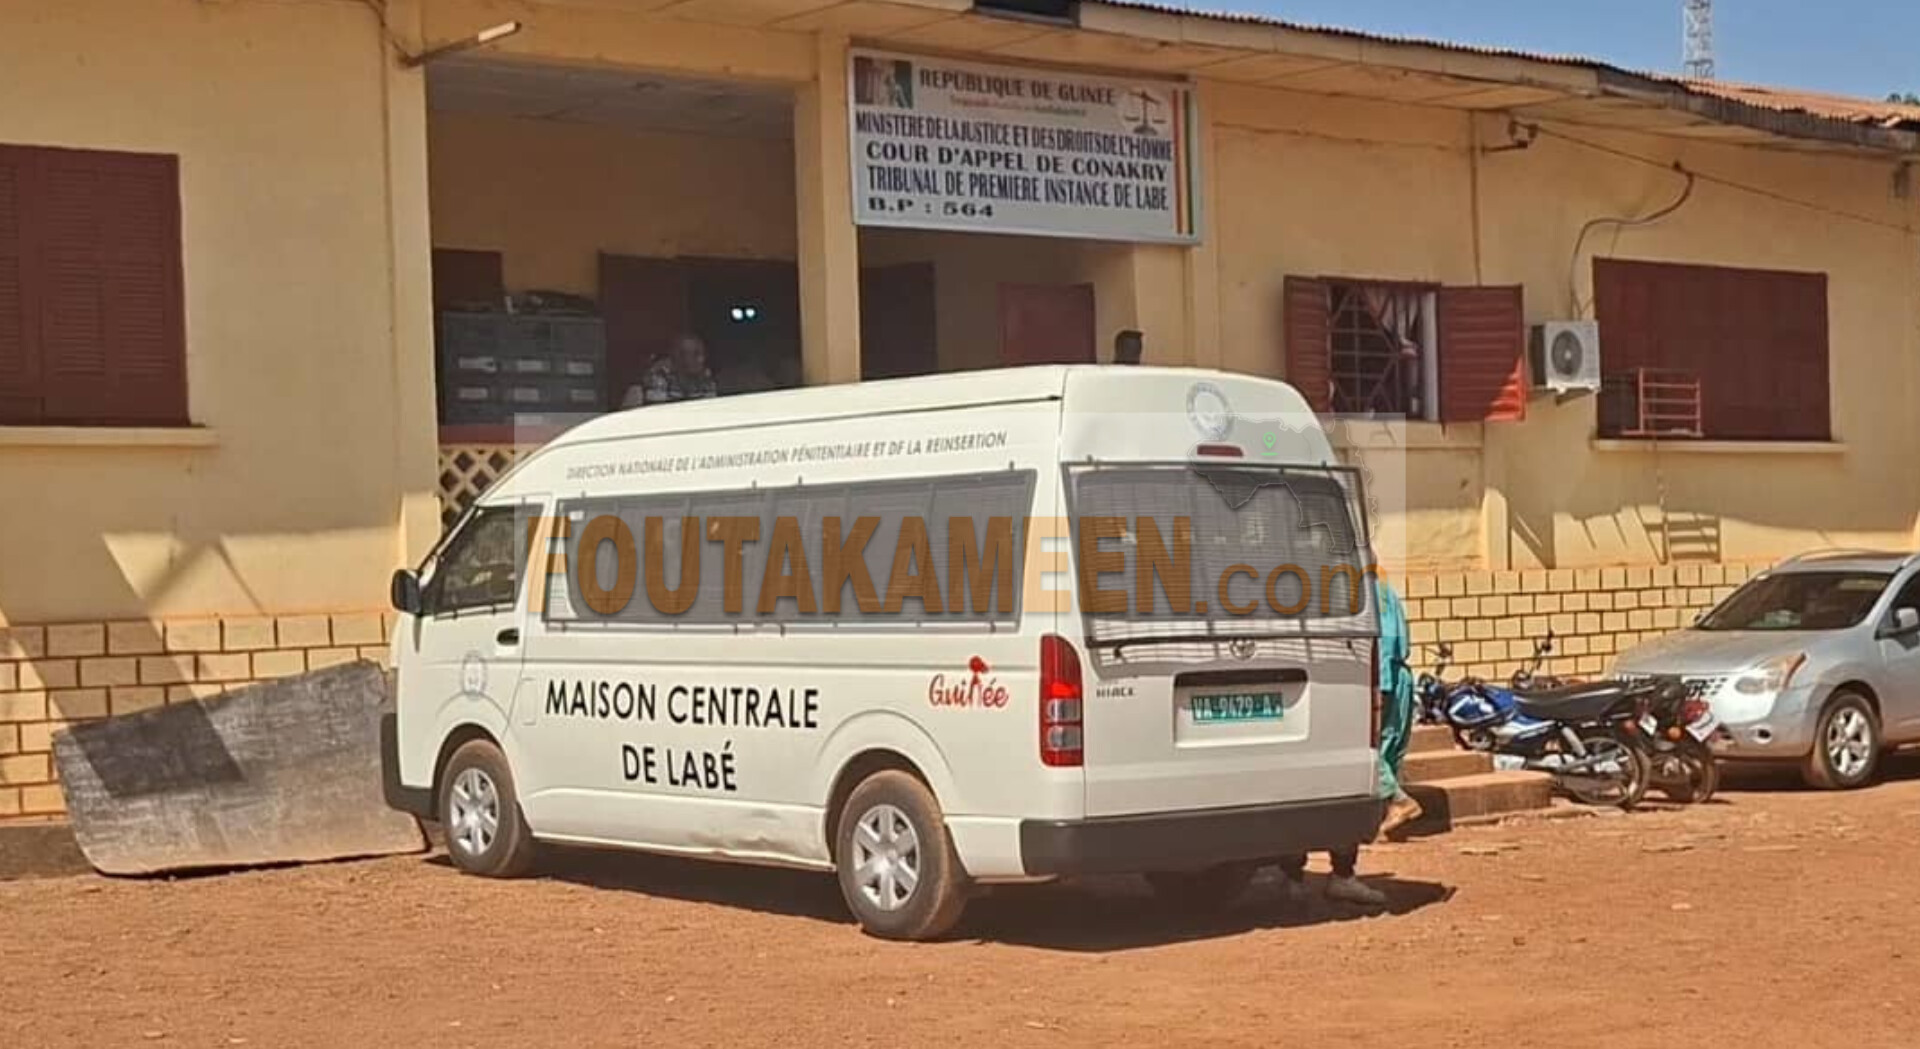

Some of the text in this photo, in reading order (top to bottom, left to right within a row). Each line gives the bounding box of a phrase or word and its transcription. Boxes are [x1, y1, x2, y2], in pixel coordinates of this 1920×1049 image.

[1031, 80, 1052, 100] DE
[1013, 124, 1029, 147] ET
[1032, 127, 1056, 151] DES
[866, 140, 1167, 182] COUR D'APPEL DE CONAKRY
[867, 164, 941, 195] TRIBUNAL
[945, 171, 965, 197] DE
[969, 173, 1041, 203] PREMIERE
[1045, 178, 1110, 208] INSTANCE
[1114, 184, 1132, 209] DE
[868, 197, 914, 212] B.P
[943, 201, 994, 217] 564
[566, 463, 616, 480] DIRECTION
[618, 459, 673, 475] NATIONALE
[675, 457, 690, 472] DE
[872, 441, 886, 457] ET
[906, 438, 922, 455] LA
[925, 430, 1007, 454] REINSERTION
[545, 679, 819, 728] MAISON CENTRALE
[622, 740, 737, 791] DE LABÉ
